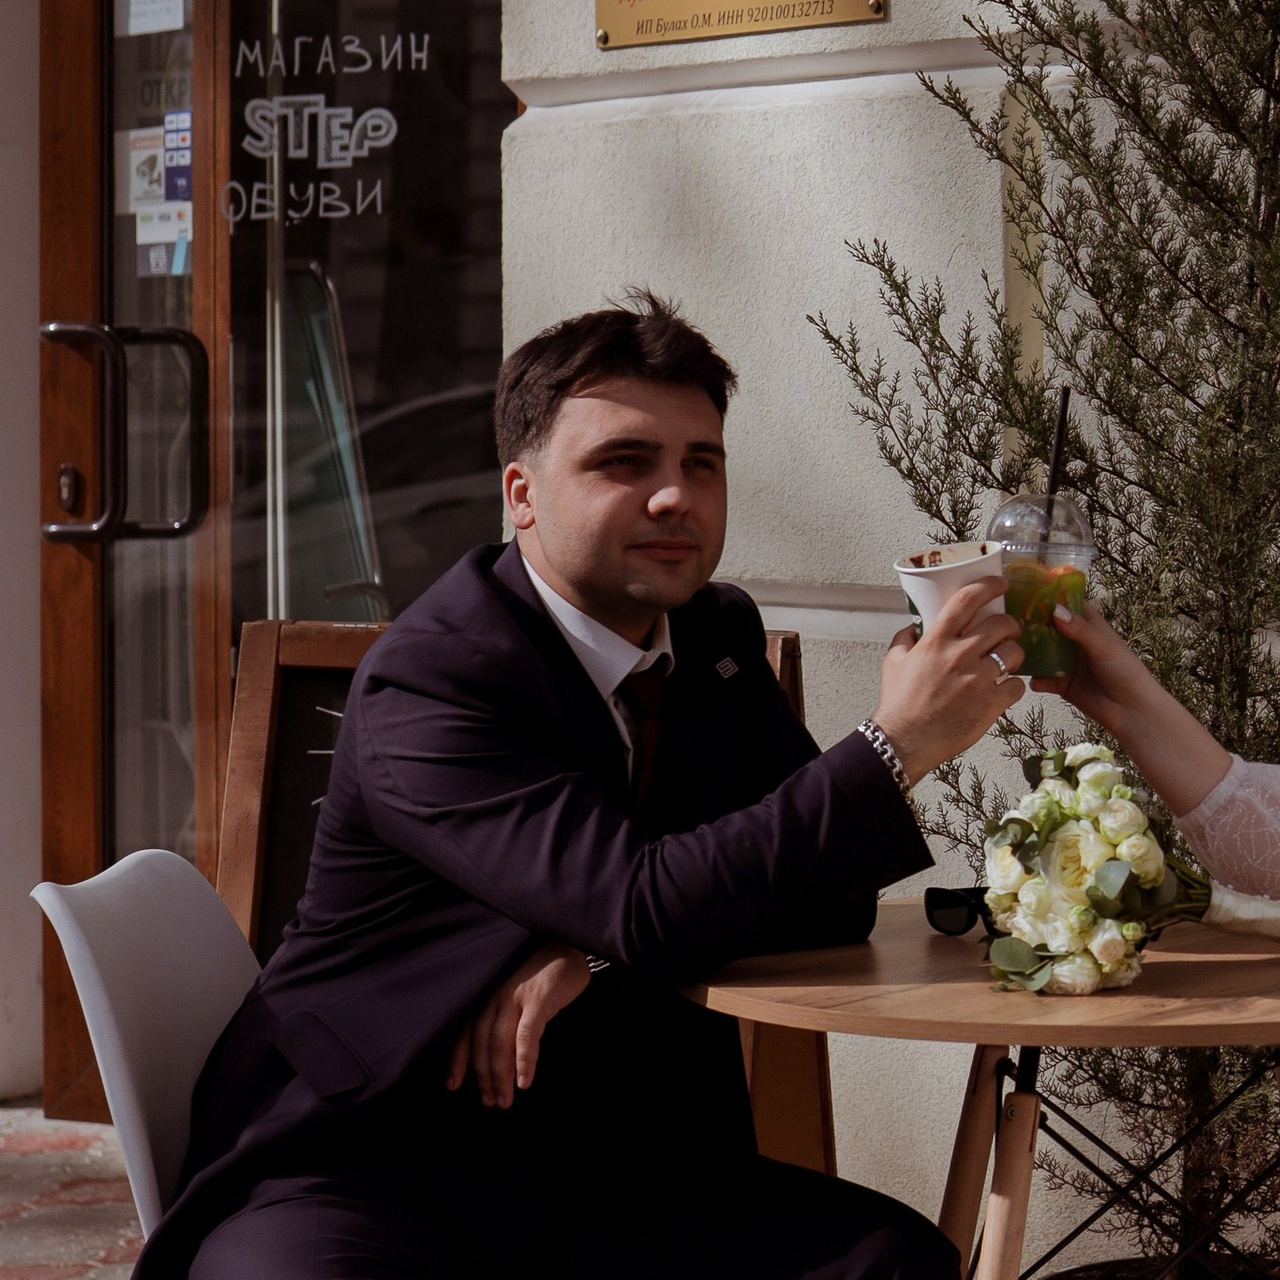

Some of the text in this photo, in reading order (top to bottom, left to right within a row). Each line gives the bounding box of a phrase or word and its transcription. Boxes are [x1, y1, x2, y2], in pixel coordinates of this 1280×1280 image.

[635, 19, 654, 36] ИП
[655, 17, 688, 37] Булах
[690, 12, 714, 29] О.М.
[716, 8, 745, 27] ИНН
[233, 32, 431, 79] МАГАЗИН
[241, 92, 399, 170] STEP
[219, 177, 383, 222] ОБУВИ
